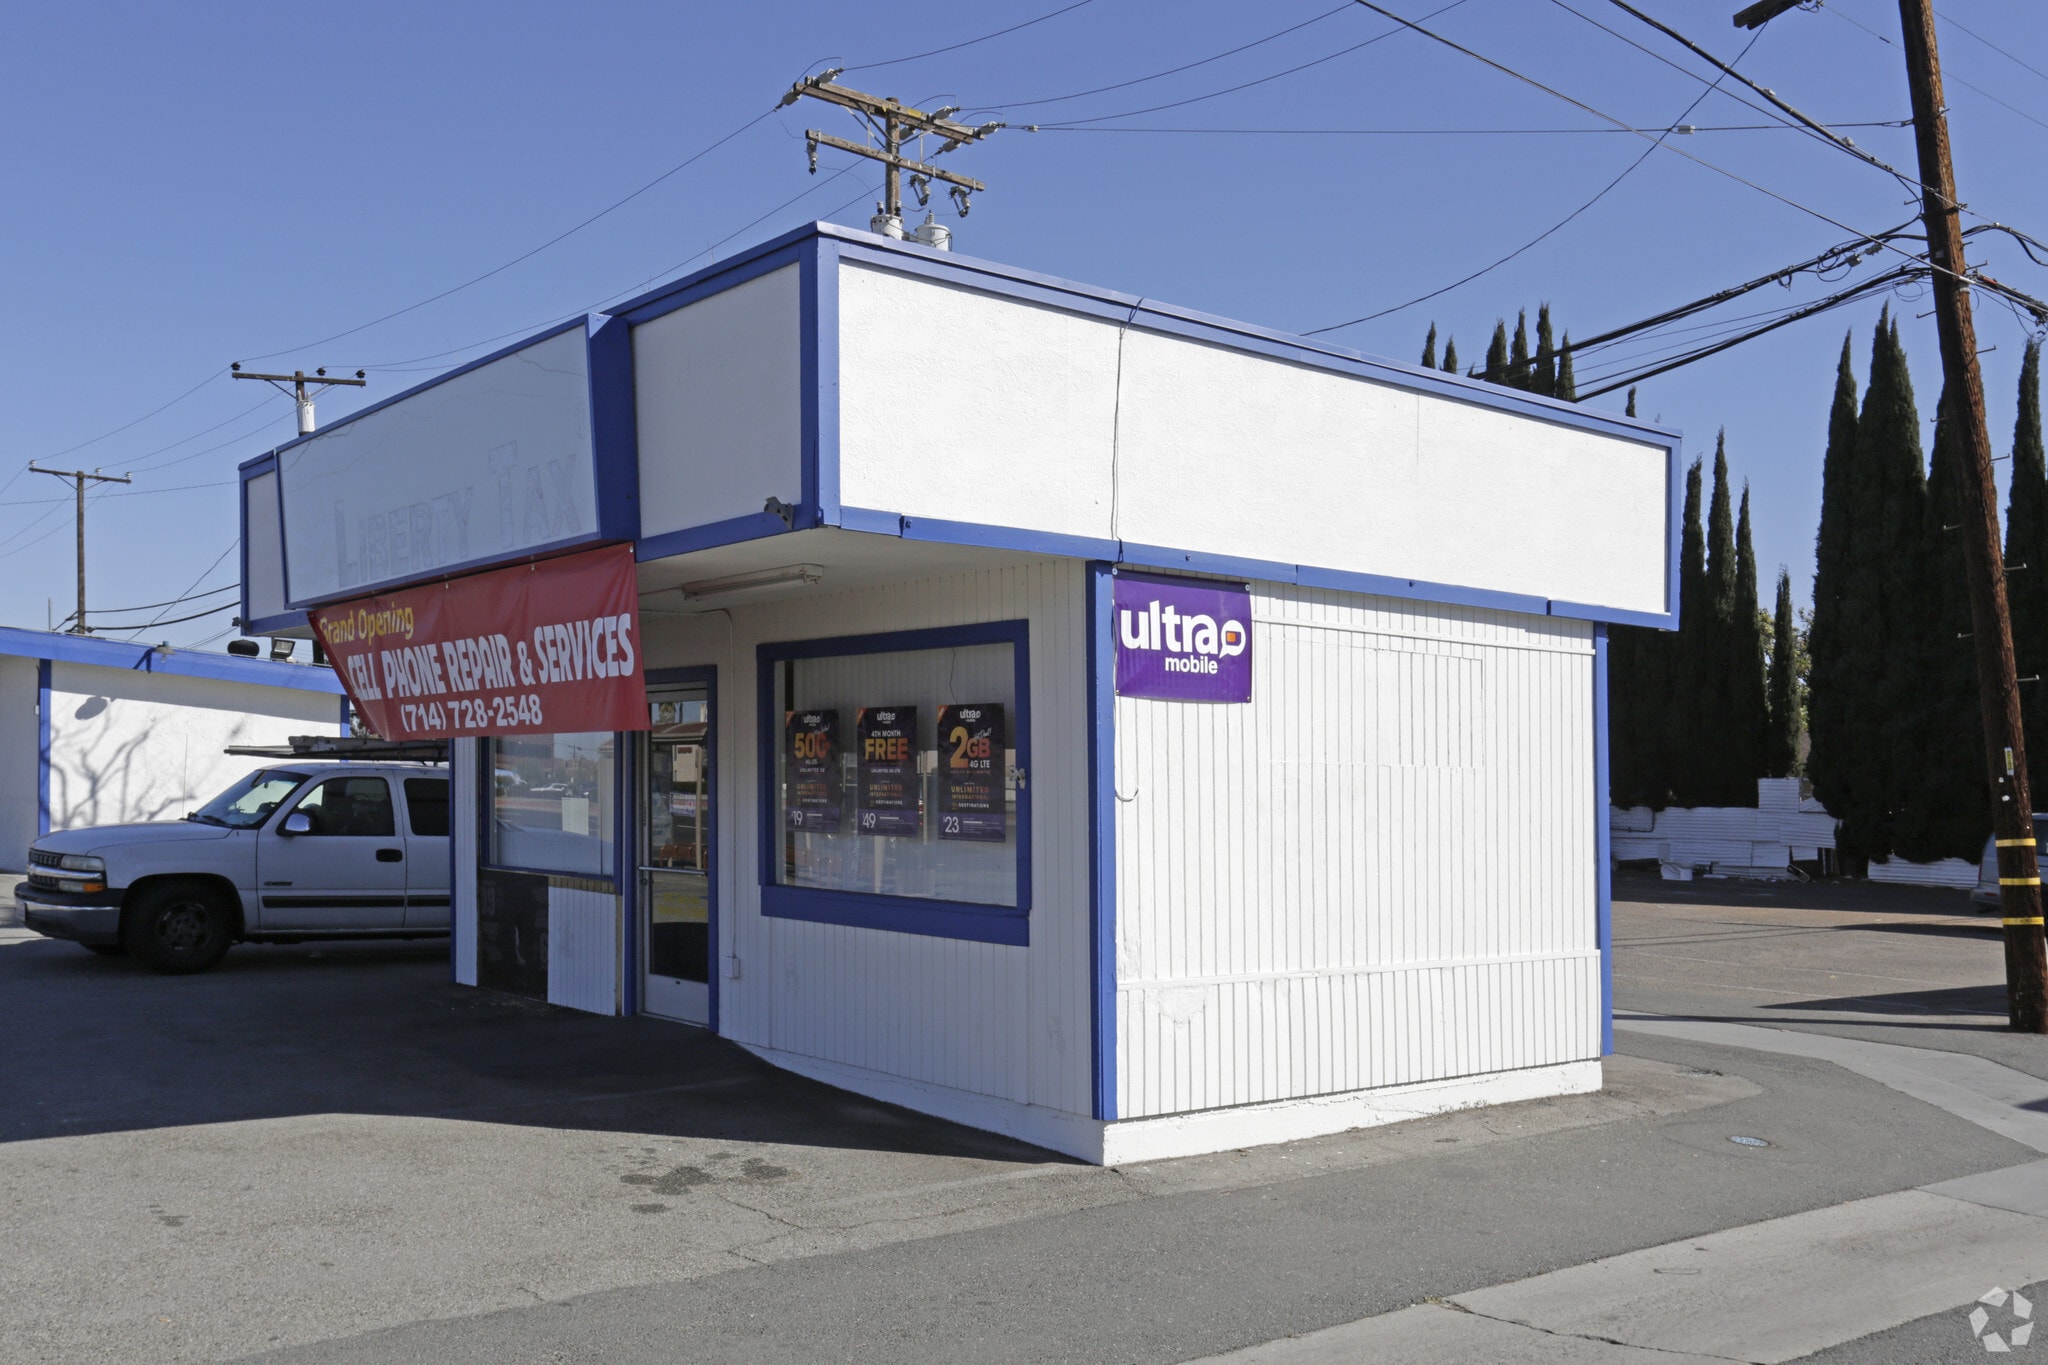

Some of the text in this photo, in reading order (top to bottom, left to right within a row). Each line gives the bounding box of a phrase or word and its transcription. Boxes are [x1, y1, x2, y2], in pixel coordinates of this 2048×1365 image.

[320, 602, 414, 646] Grand Opening
[1120, 600, 1218, 655] ultra
[347, 613, 635, 701] CELL PHONE REPAIR & SERVICES
[1165, 655, 1218, 674] mobile
[401, 694, 543, 732] (714) 728-2548
[960, 708, 976, 719] ultra
[865, 737, 908, 760] FREE
[970, 760, 991, 768] 4G LTE
